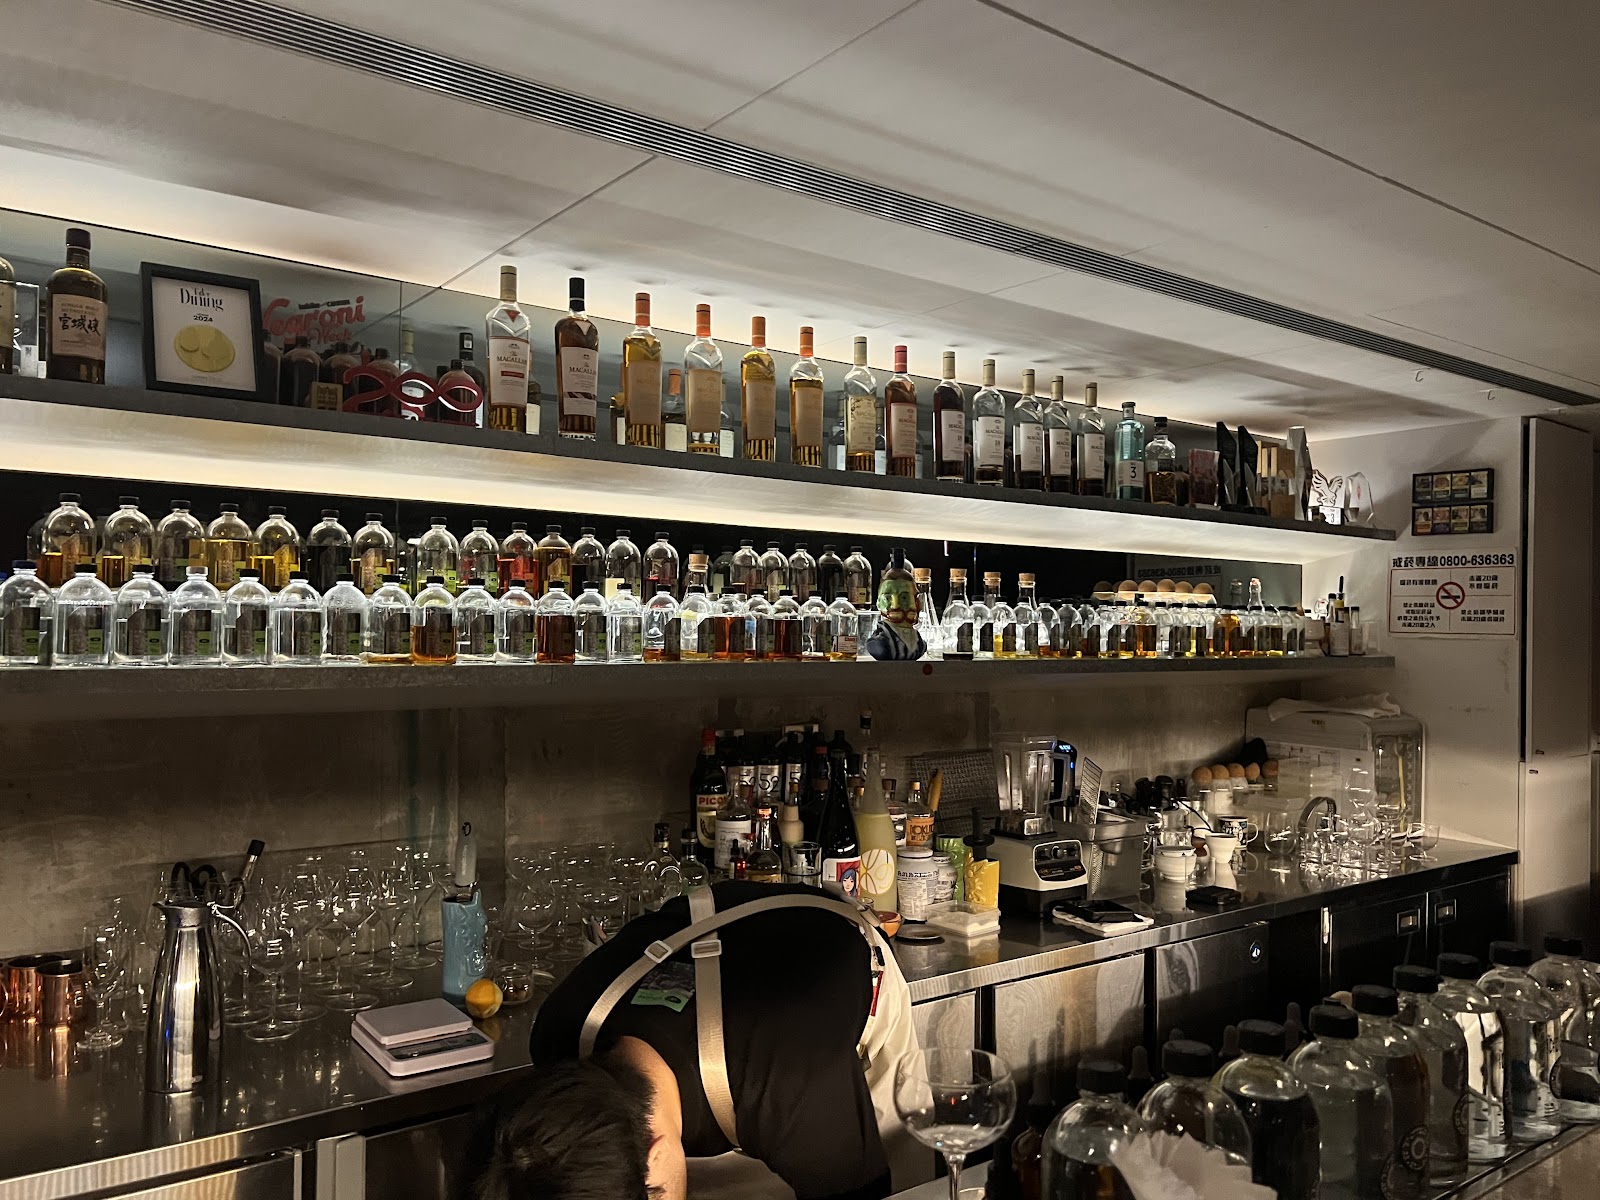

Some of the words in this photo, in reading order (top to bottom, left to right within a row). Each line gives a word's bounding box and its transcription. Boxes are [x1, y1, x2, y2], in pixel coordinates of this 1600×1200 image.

[180, 288, 224, 311] Dining
[569, 366, 596, 375] MACALL
[1130, 466, 1136, 478] 3
[758, 773, 779, 794] 52
[699, 797, 726, 805] PICO
